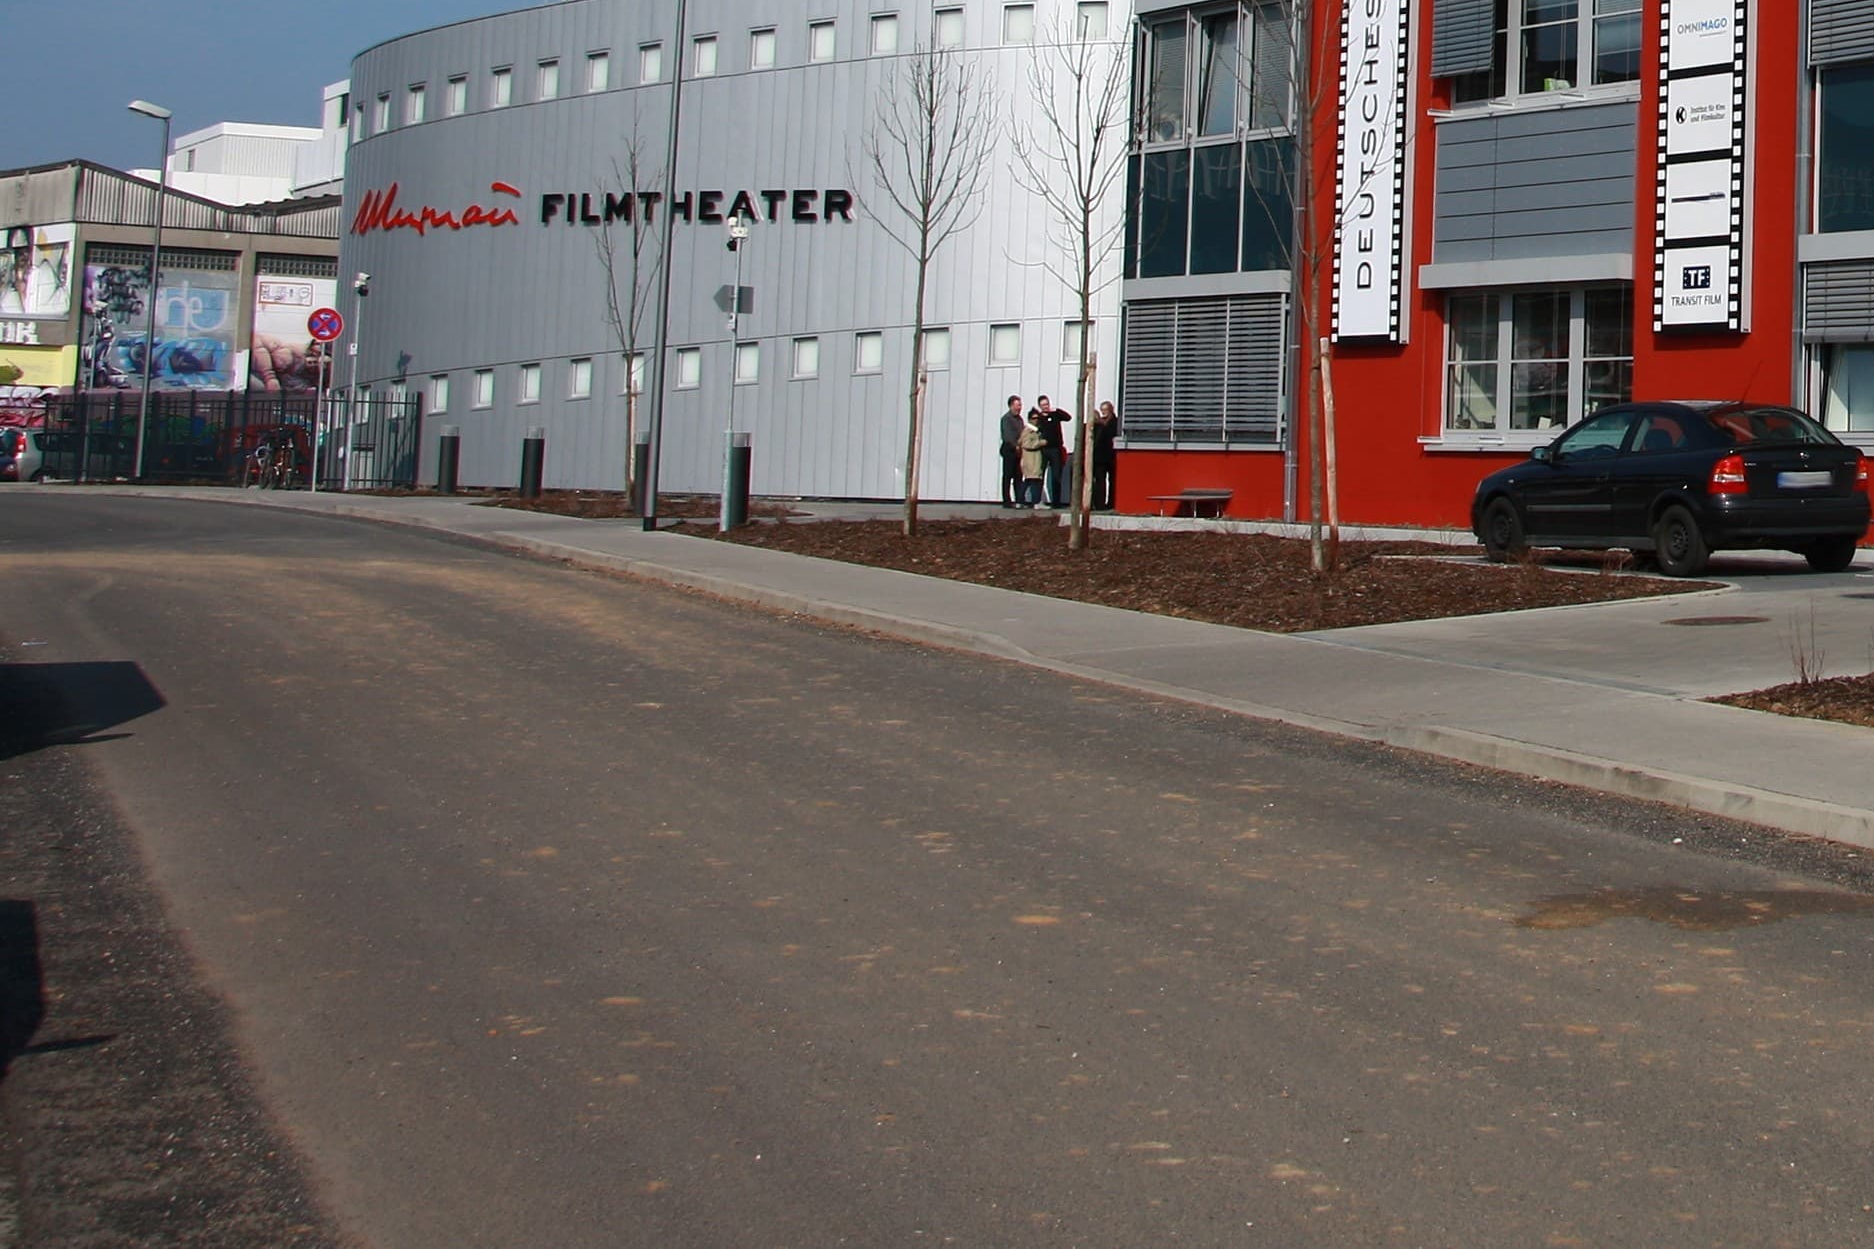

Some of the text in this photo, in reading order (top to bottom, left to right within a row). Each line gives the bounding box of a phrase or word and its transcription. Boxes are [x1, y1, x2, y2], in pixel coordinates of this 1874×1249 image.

[1677, 17, 1728, 35] OMNIMAGO
[541, 189, 854, 224] FILMTHEATER
[1688, 269, 1706, 287] TF
[1671, 294, 1721, 307] TRANSIT FILM
